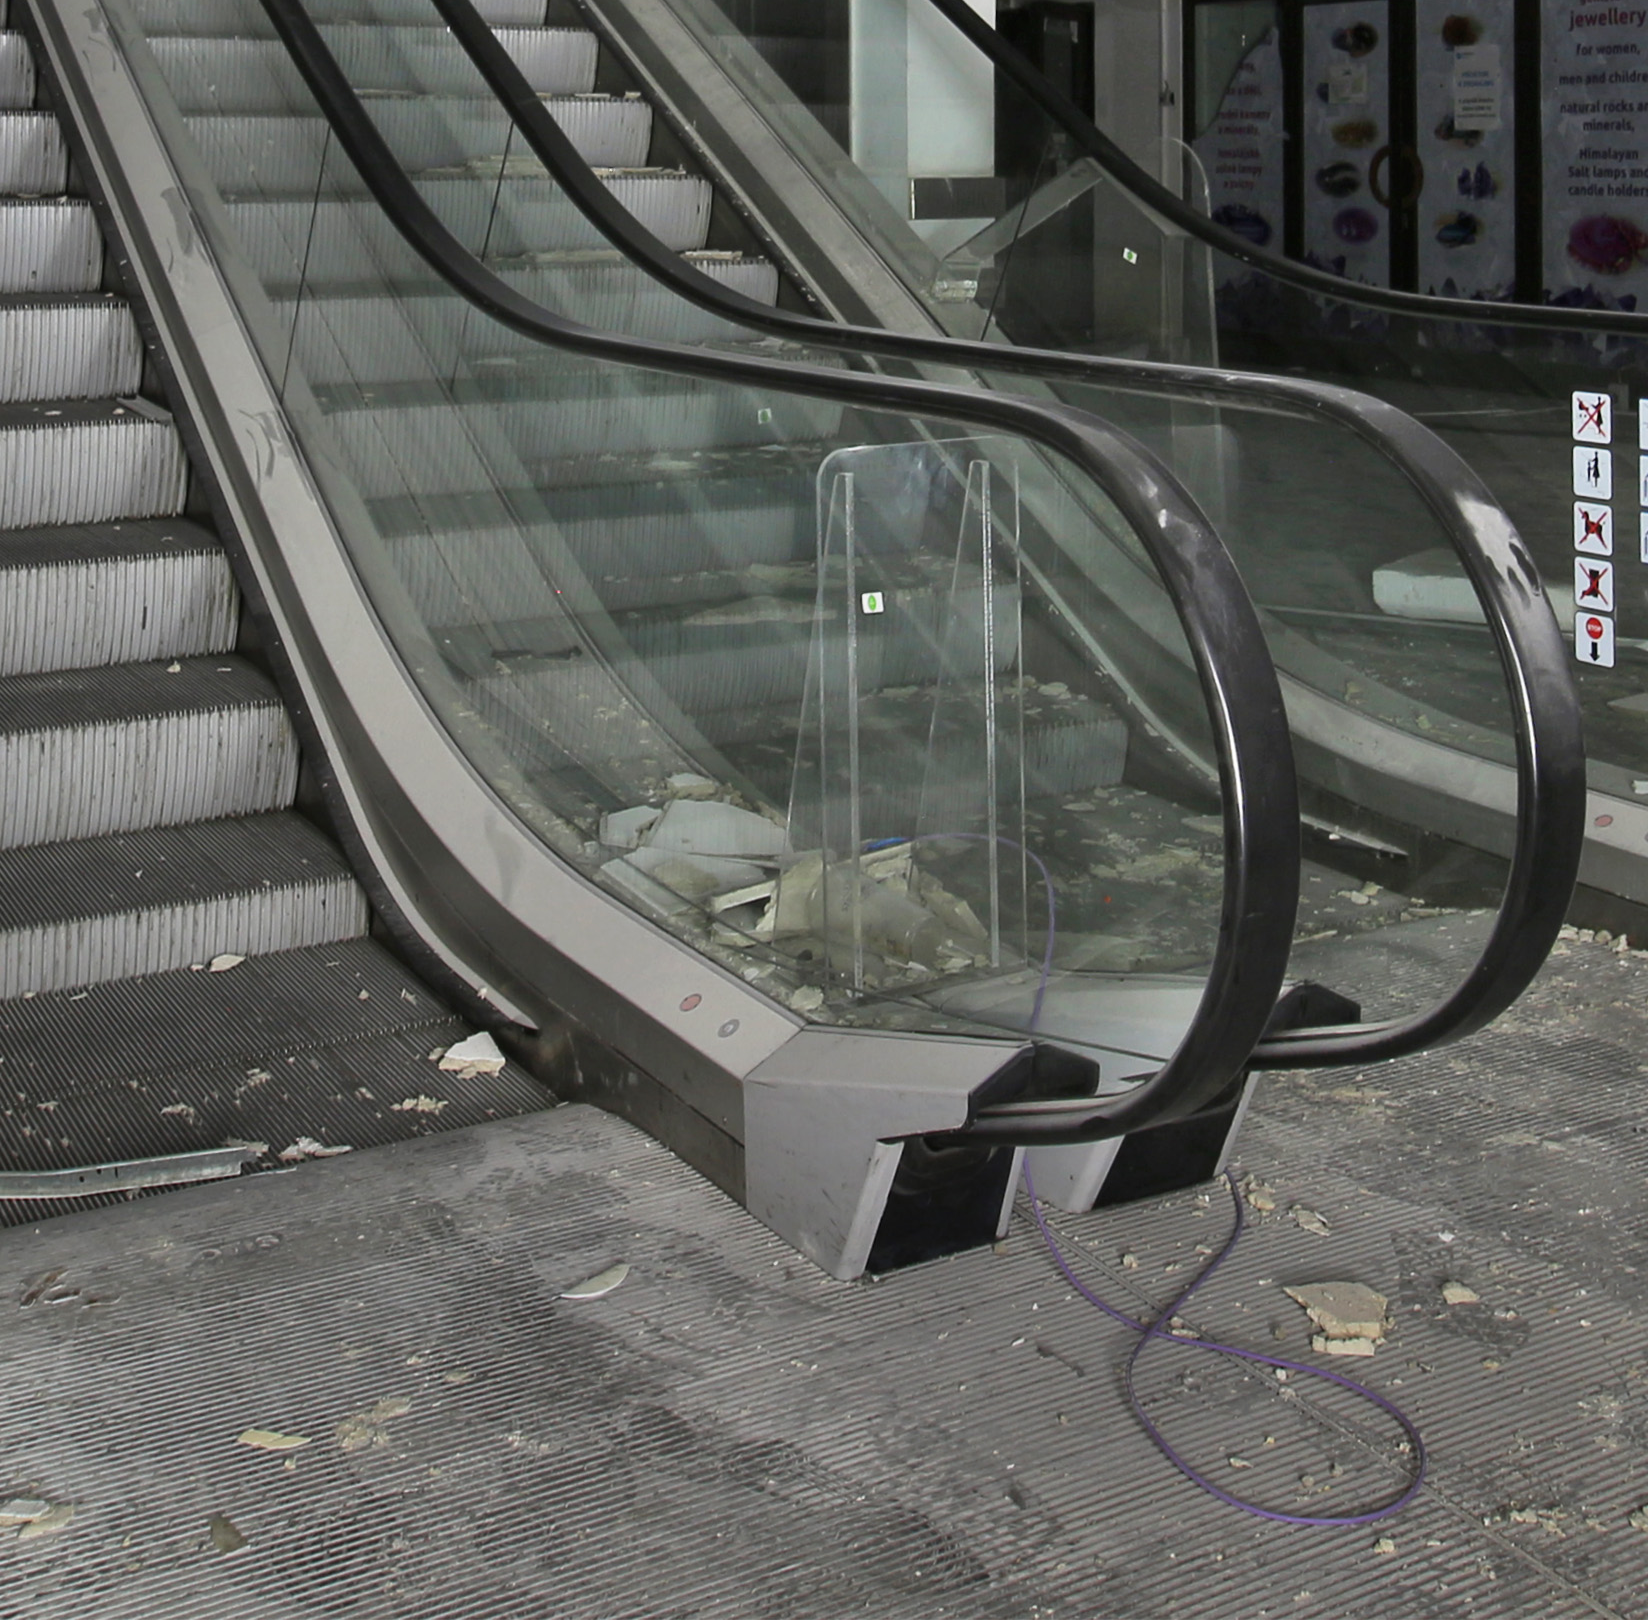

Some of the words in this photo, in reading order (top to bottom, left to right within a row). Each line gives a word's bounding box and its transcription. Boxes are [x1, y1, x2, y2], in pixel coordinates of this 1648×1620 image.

[1568, 7, 1647, 32] jewellery
[1576, 43, 1593, 56] for
[1596, 43, 1641, 56] women,
[1559, 73, 1583, 85] men
[1585, 72, 1606, 85] and
[1560, 100, 1600, 114] natural
[1603, 100, 1634, 113] rocks
[1583, 118, 1635, 132] minerals,
[1579, 147, 1639, 163] Himalayan
[1568, 166, 1590, 178] Salt
[1593, 166, 1627, 181] lamps
[1568, 183, 1604, 197] candle
